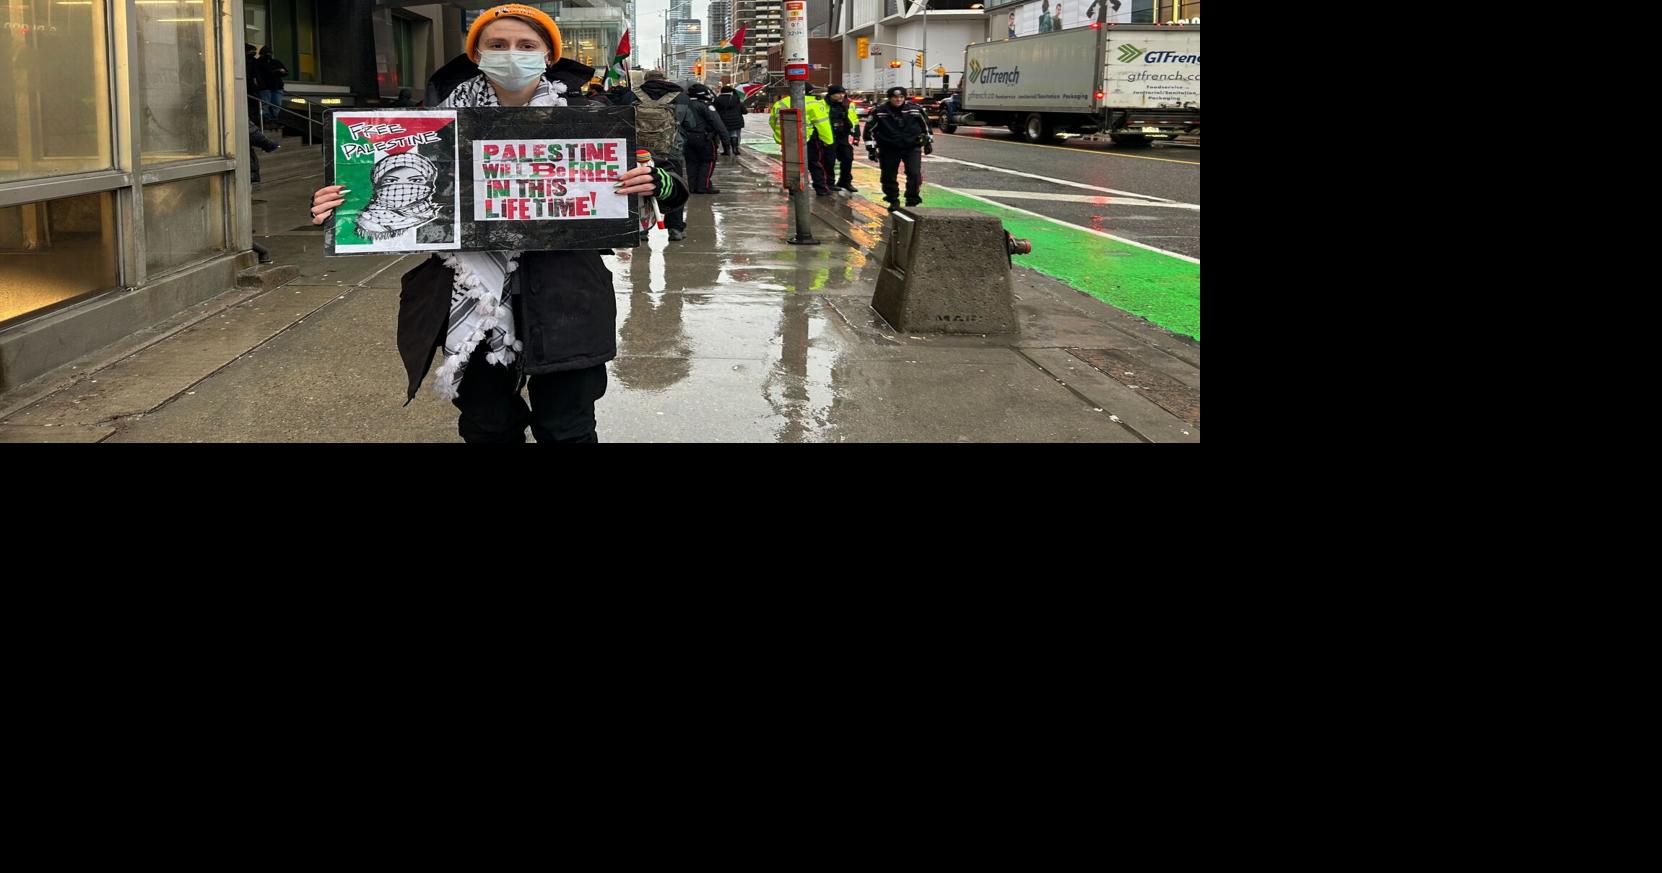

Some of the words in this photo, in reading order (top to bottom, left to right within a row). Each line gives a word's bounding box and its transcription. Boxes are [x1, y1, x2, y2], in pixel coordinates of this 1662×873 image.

[980, 66, 1019, 84] GTFrench
[349, 122, 406, 140] FREE
[341, 131, 442, 160] PALESTINE
[568, 161, 620, 183] FREE
